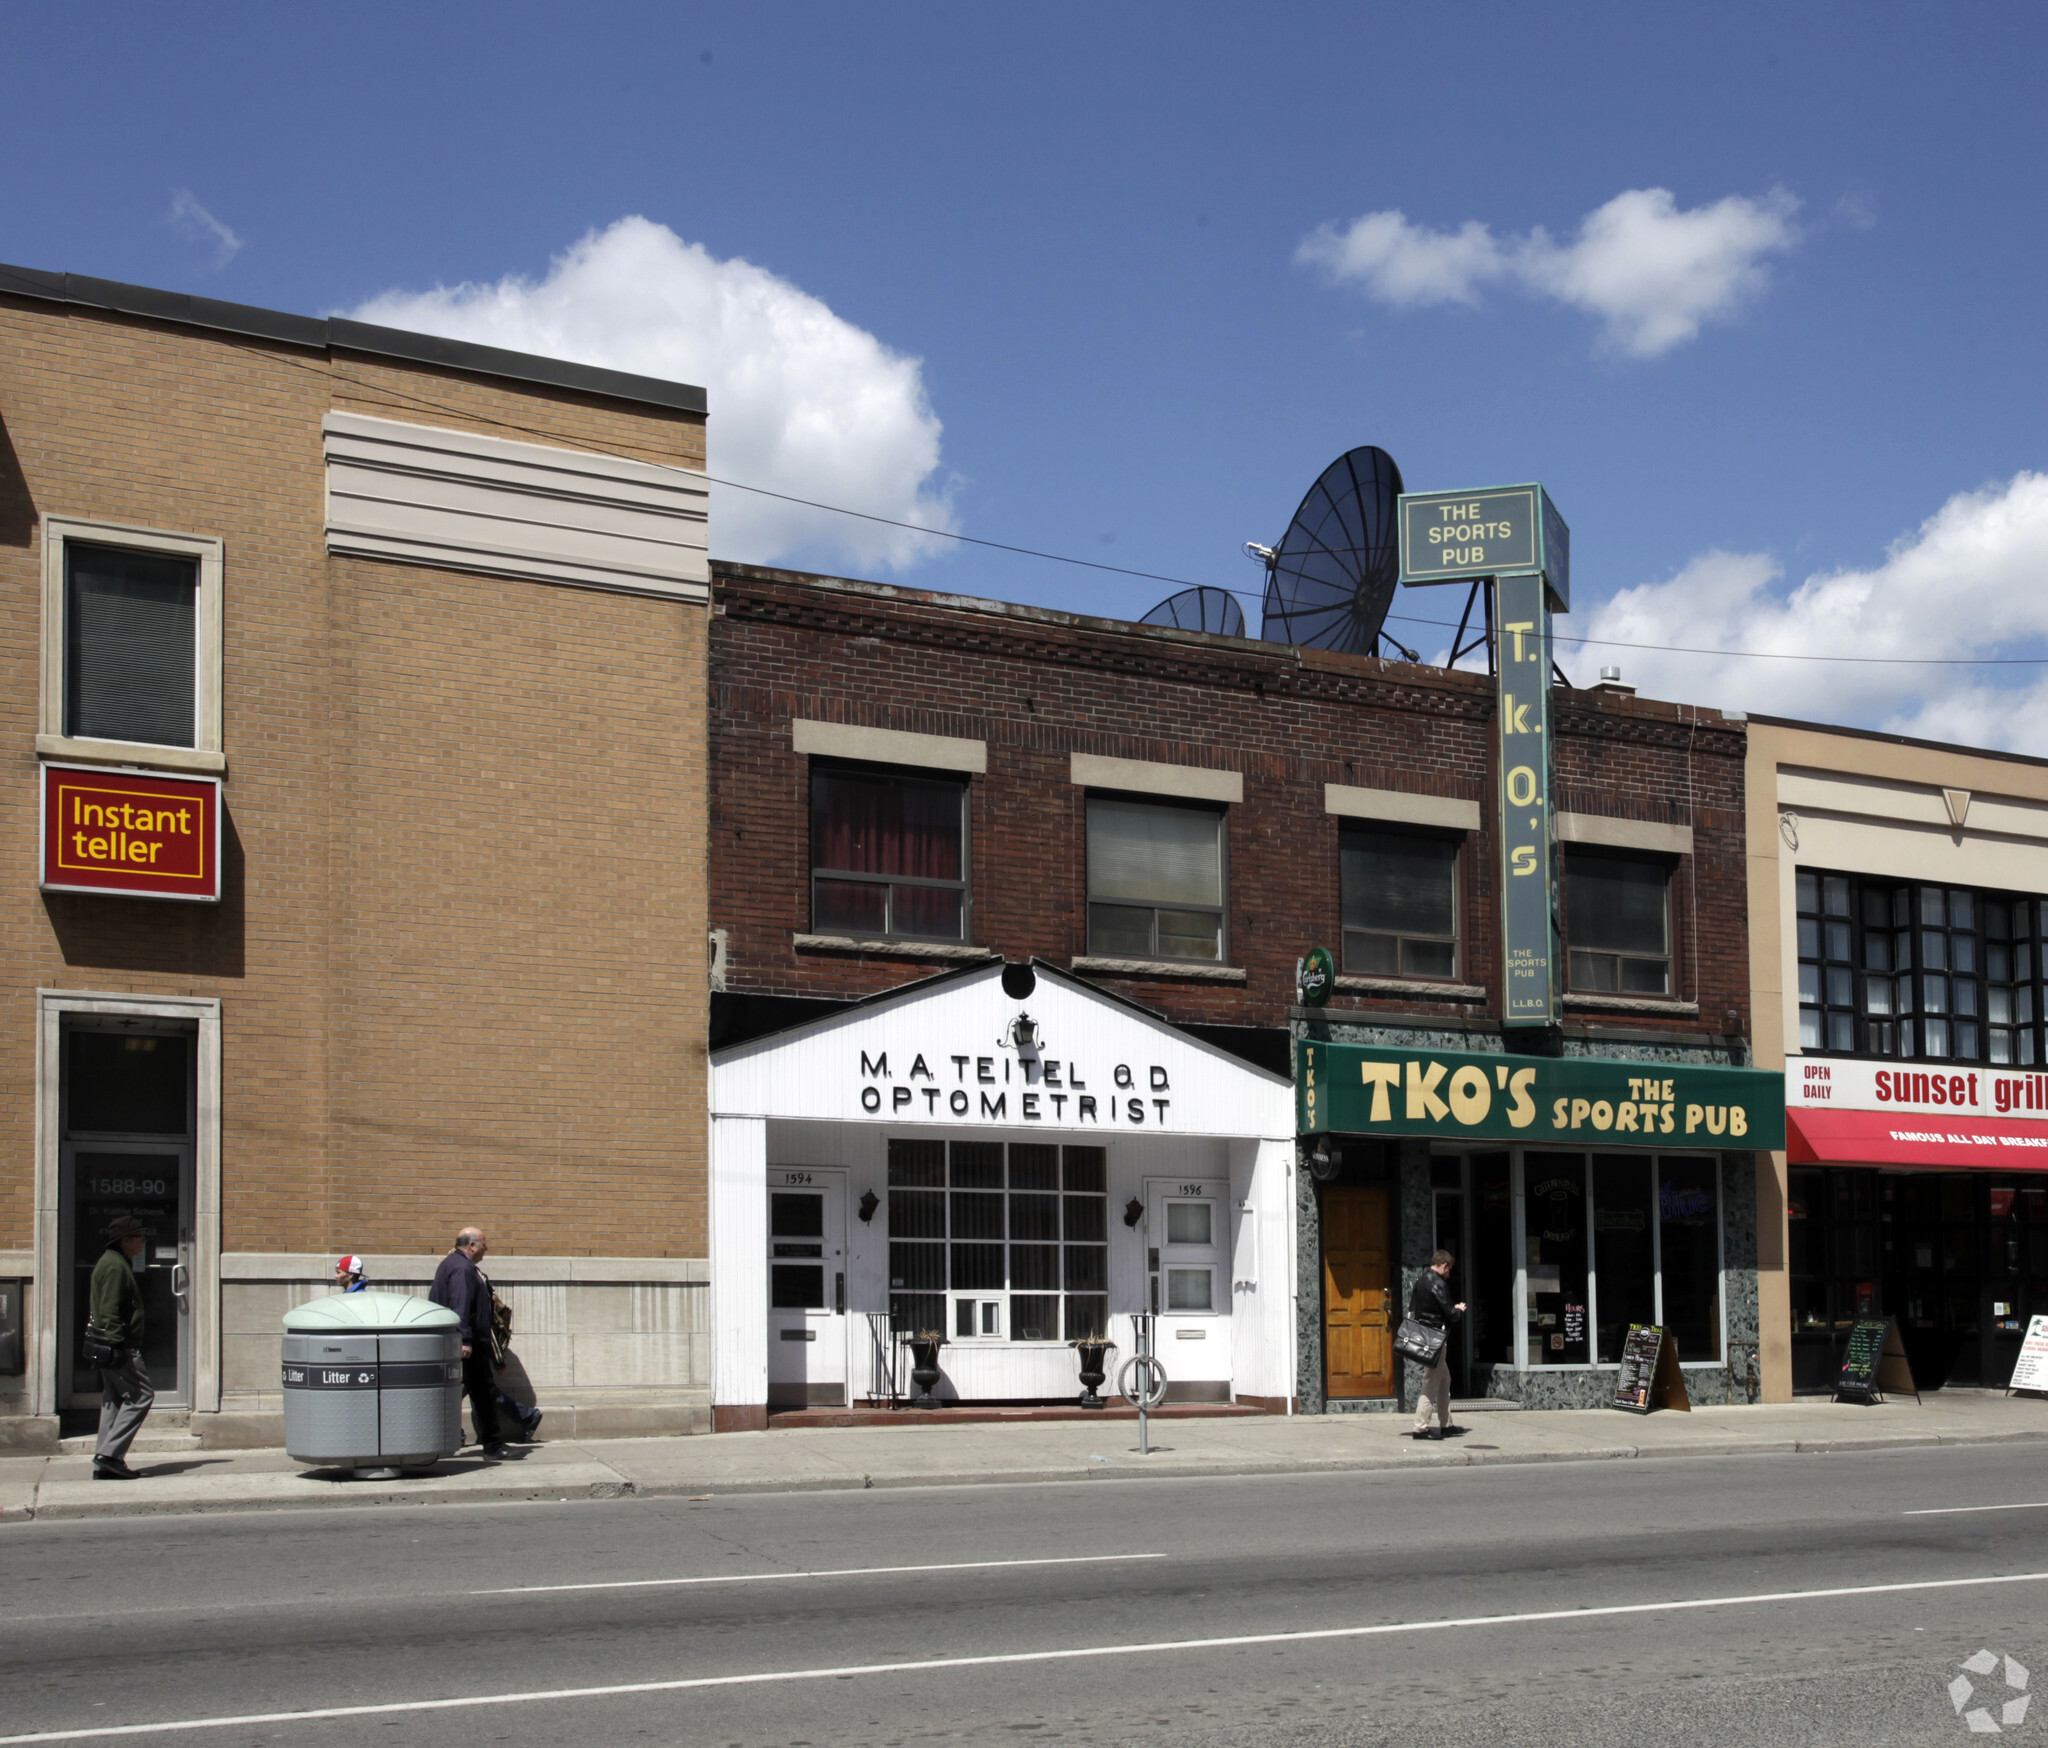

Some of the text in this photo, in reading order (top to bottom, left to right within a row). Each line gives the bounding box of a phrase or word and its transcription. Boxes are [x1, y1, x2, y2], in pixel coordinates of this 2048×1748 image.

[1439, 503, 1481, 521] THE
[1428, 521, 1512, 544] SPORTS
[1443, 546, 1485, 566] PUB
[74, 796, 191, 835] Instant
[72, 831, 163, 864] teller
[1508, 958, 1547, 968] SPORTS
[1512, 949, 1533, 958] THE
[1514, 969, 1535, 978] PUB
[861, 1050, 892, 1078] M.
[909, 1053, 934, 1080] A.
[950, 1055, 1086, 1086] TEITEL
[1804, 1065, 1832, 1081] OPEN
[1306, 1047, 1317, 1130] TKO'S
[1361, 1060, 1537, 1129] TKO'S
[1628, 1078, 1675, 1102] THE
[1803, 1084, 1832, 1100] DAILY
[1875, 1070, 1979, 1107] sunset
[861, 1086, 1171, 1125] OPTOMETRIST
[1551, 1097, 1749, 1137] SPORTS PUB
[1889, 1131, 1946, 1143] FAMOUS
[1946, 1134, 1973, 1145] ALL
[1971, 1135, 1998, 1146] DAY
[90, 1179, 166, 1195] 1588-90
[785, 1172, 812, 1185] 1594
[1179, 1184, 1202, 1196] 1596
[1659, 1192, 1709, 1219] Blue
[288, 1369, 304, 1382] Litter
[323, 1370, 350, 1384] Litter
